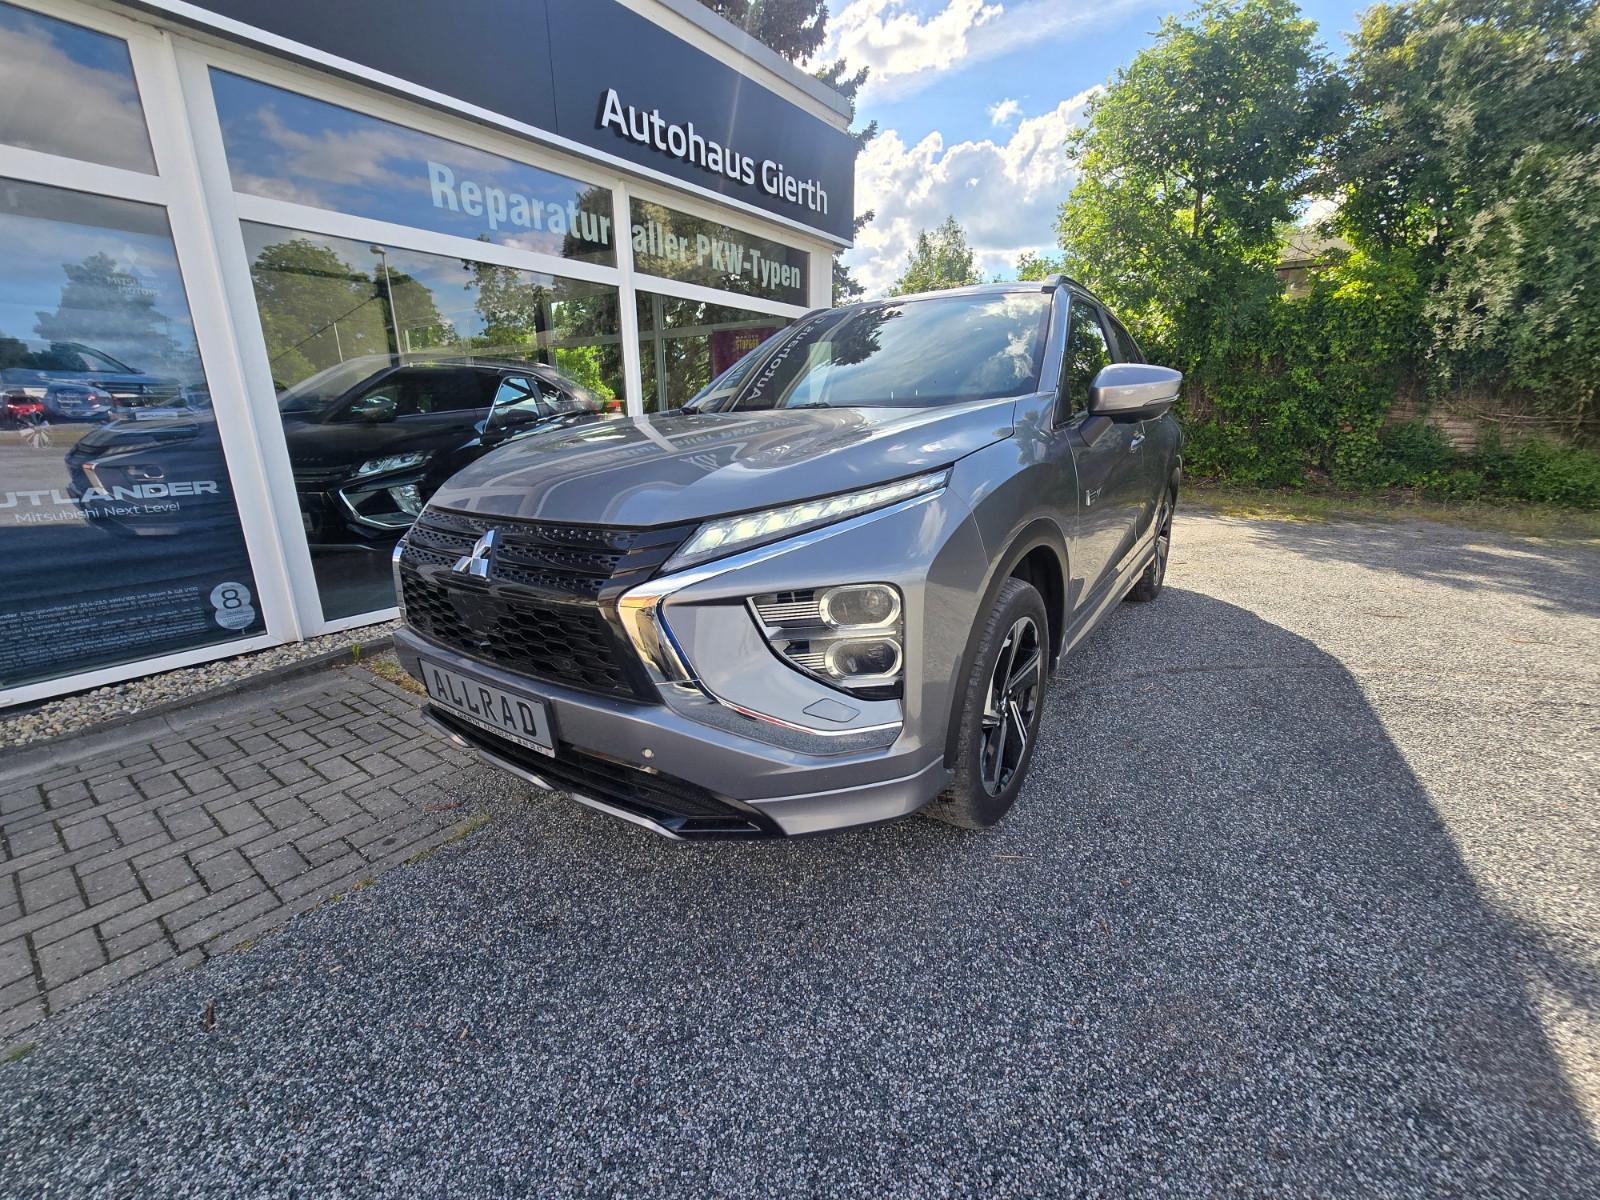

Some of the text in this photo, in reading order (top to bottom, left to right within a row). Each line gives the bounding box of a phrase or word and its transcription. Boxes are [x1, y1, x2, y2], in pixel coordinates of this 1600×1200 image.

[600, 87, 828, 215] Autohaus Gierth
[427, 160, 801, 290] Reparatur aller PKW-Typen
[15, 501, 180, 524] Mitsubishi Next Level
[221, 589, 242, 609] 8
[432, 668, 538, 738] ALLRAD
